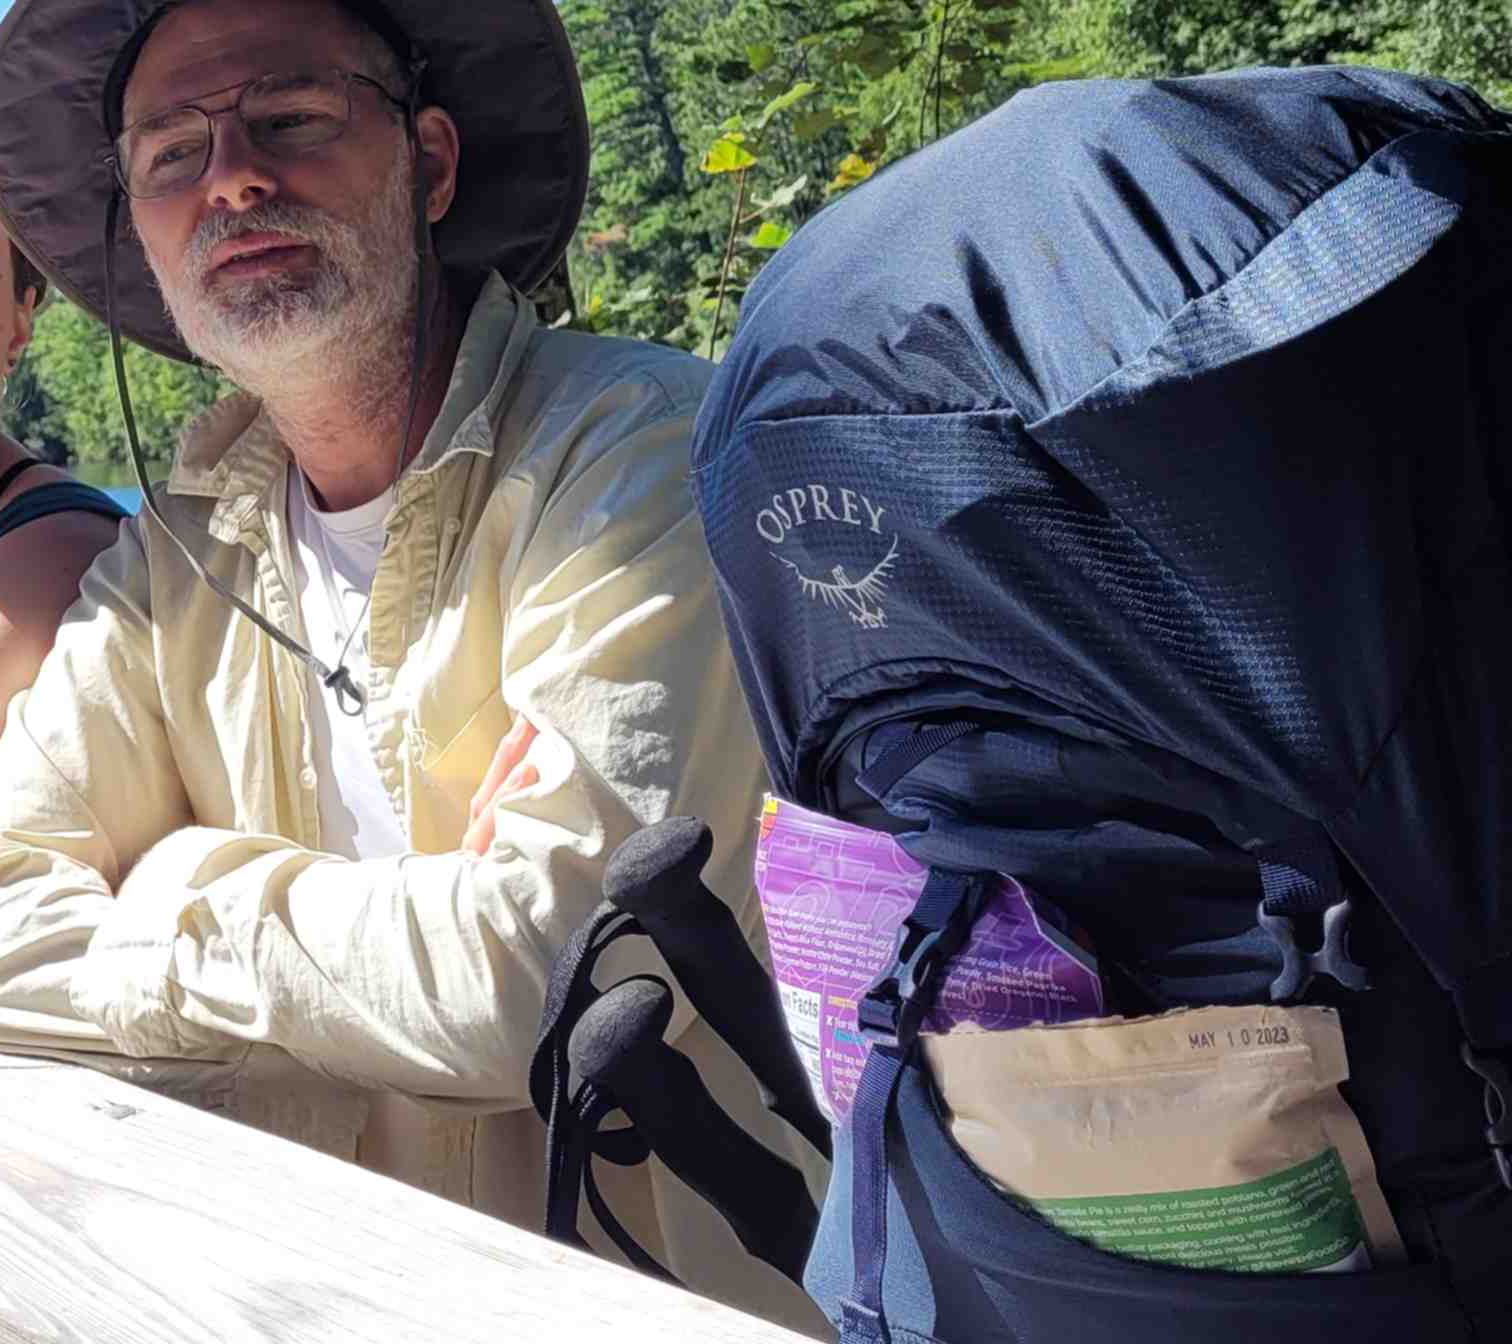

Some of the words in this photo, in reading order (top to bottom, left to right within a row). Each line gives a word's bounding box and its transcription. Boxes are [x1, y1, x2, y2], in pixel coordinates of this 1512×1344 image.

[755, 483, 887, 544] OSPREY
[1187, 1031, 1216, 1049] MAY
[1255, 1026, 1290, 1046] 2023
